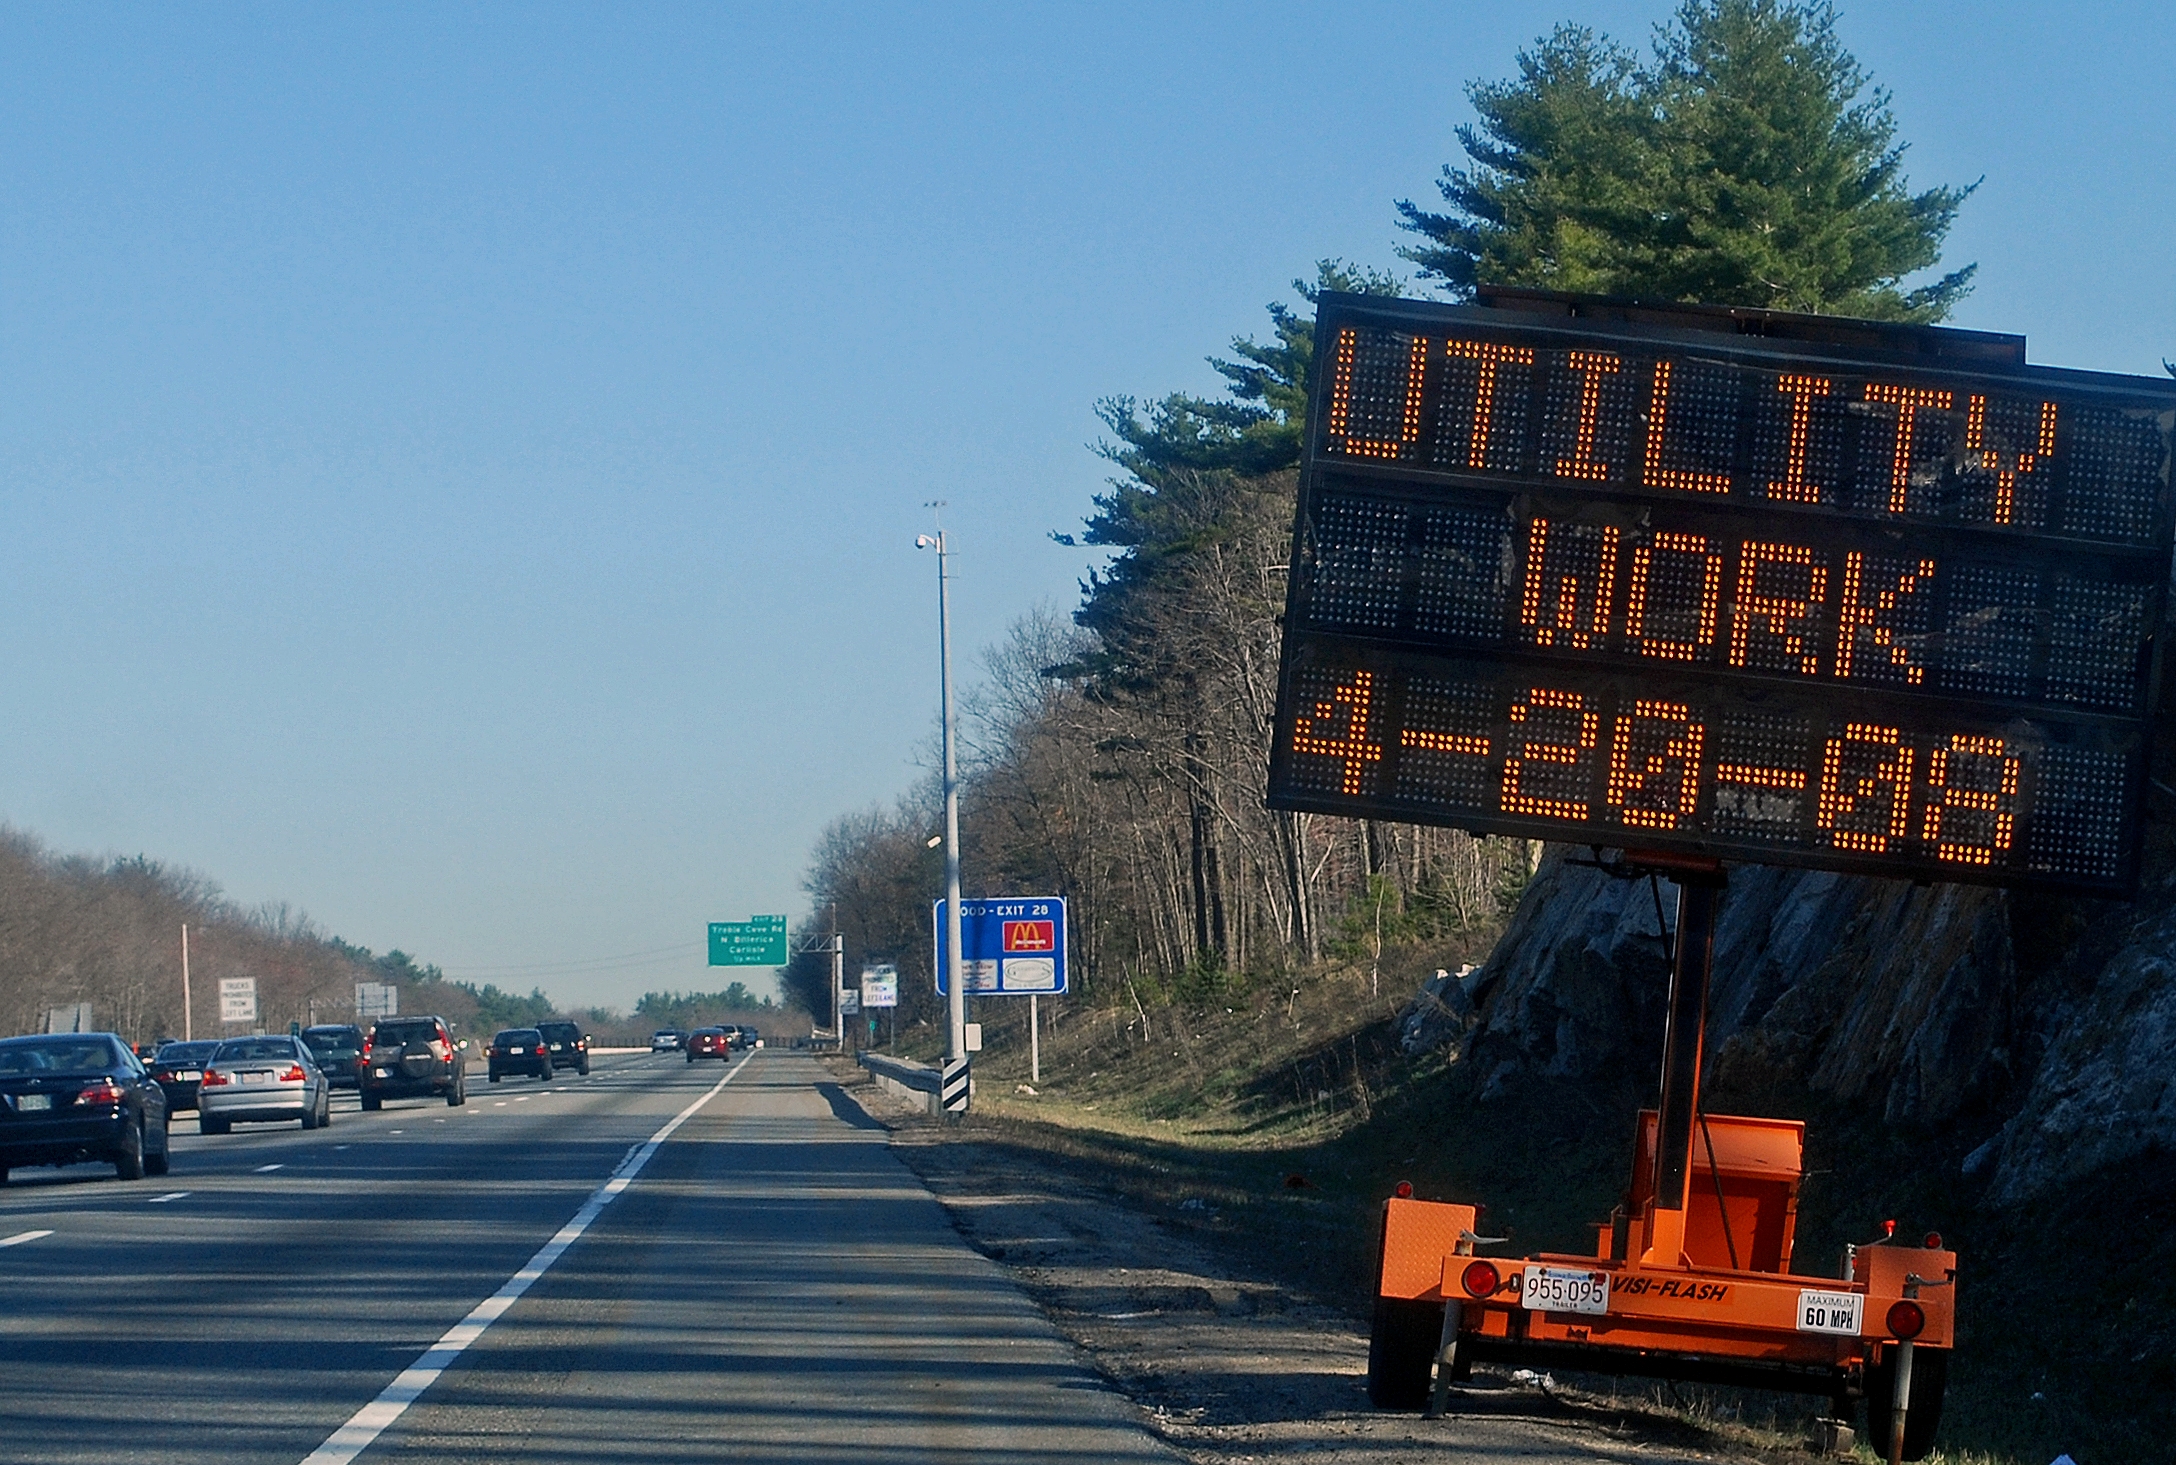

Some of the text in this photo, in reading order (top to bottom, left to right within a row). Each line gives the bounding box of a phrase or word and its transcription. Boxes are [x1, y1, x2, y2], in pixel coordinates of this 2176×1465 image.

[1328, 329, 2057, 525] UTILITY
[1521, 518, 1936, 684] WORK
[1293, 670, 2020, 865] 4-20-08
[1032, 905, 1048, 915] 28
[745, 925, 767, 933] Cove
[771, 925, 783, 933] Rd
[1611, 1276, 1728, 1302] VISI-FLASH
[1807, 1295, 1854, 1307] MAXIMUM
[1806, 1307, 1854, 1329] 60 MPH
